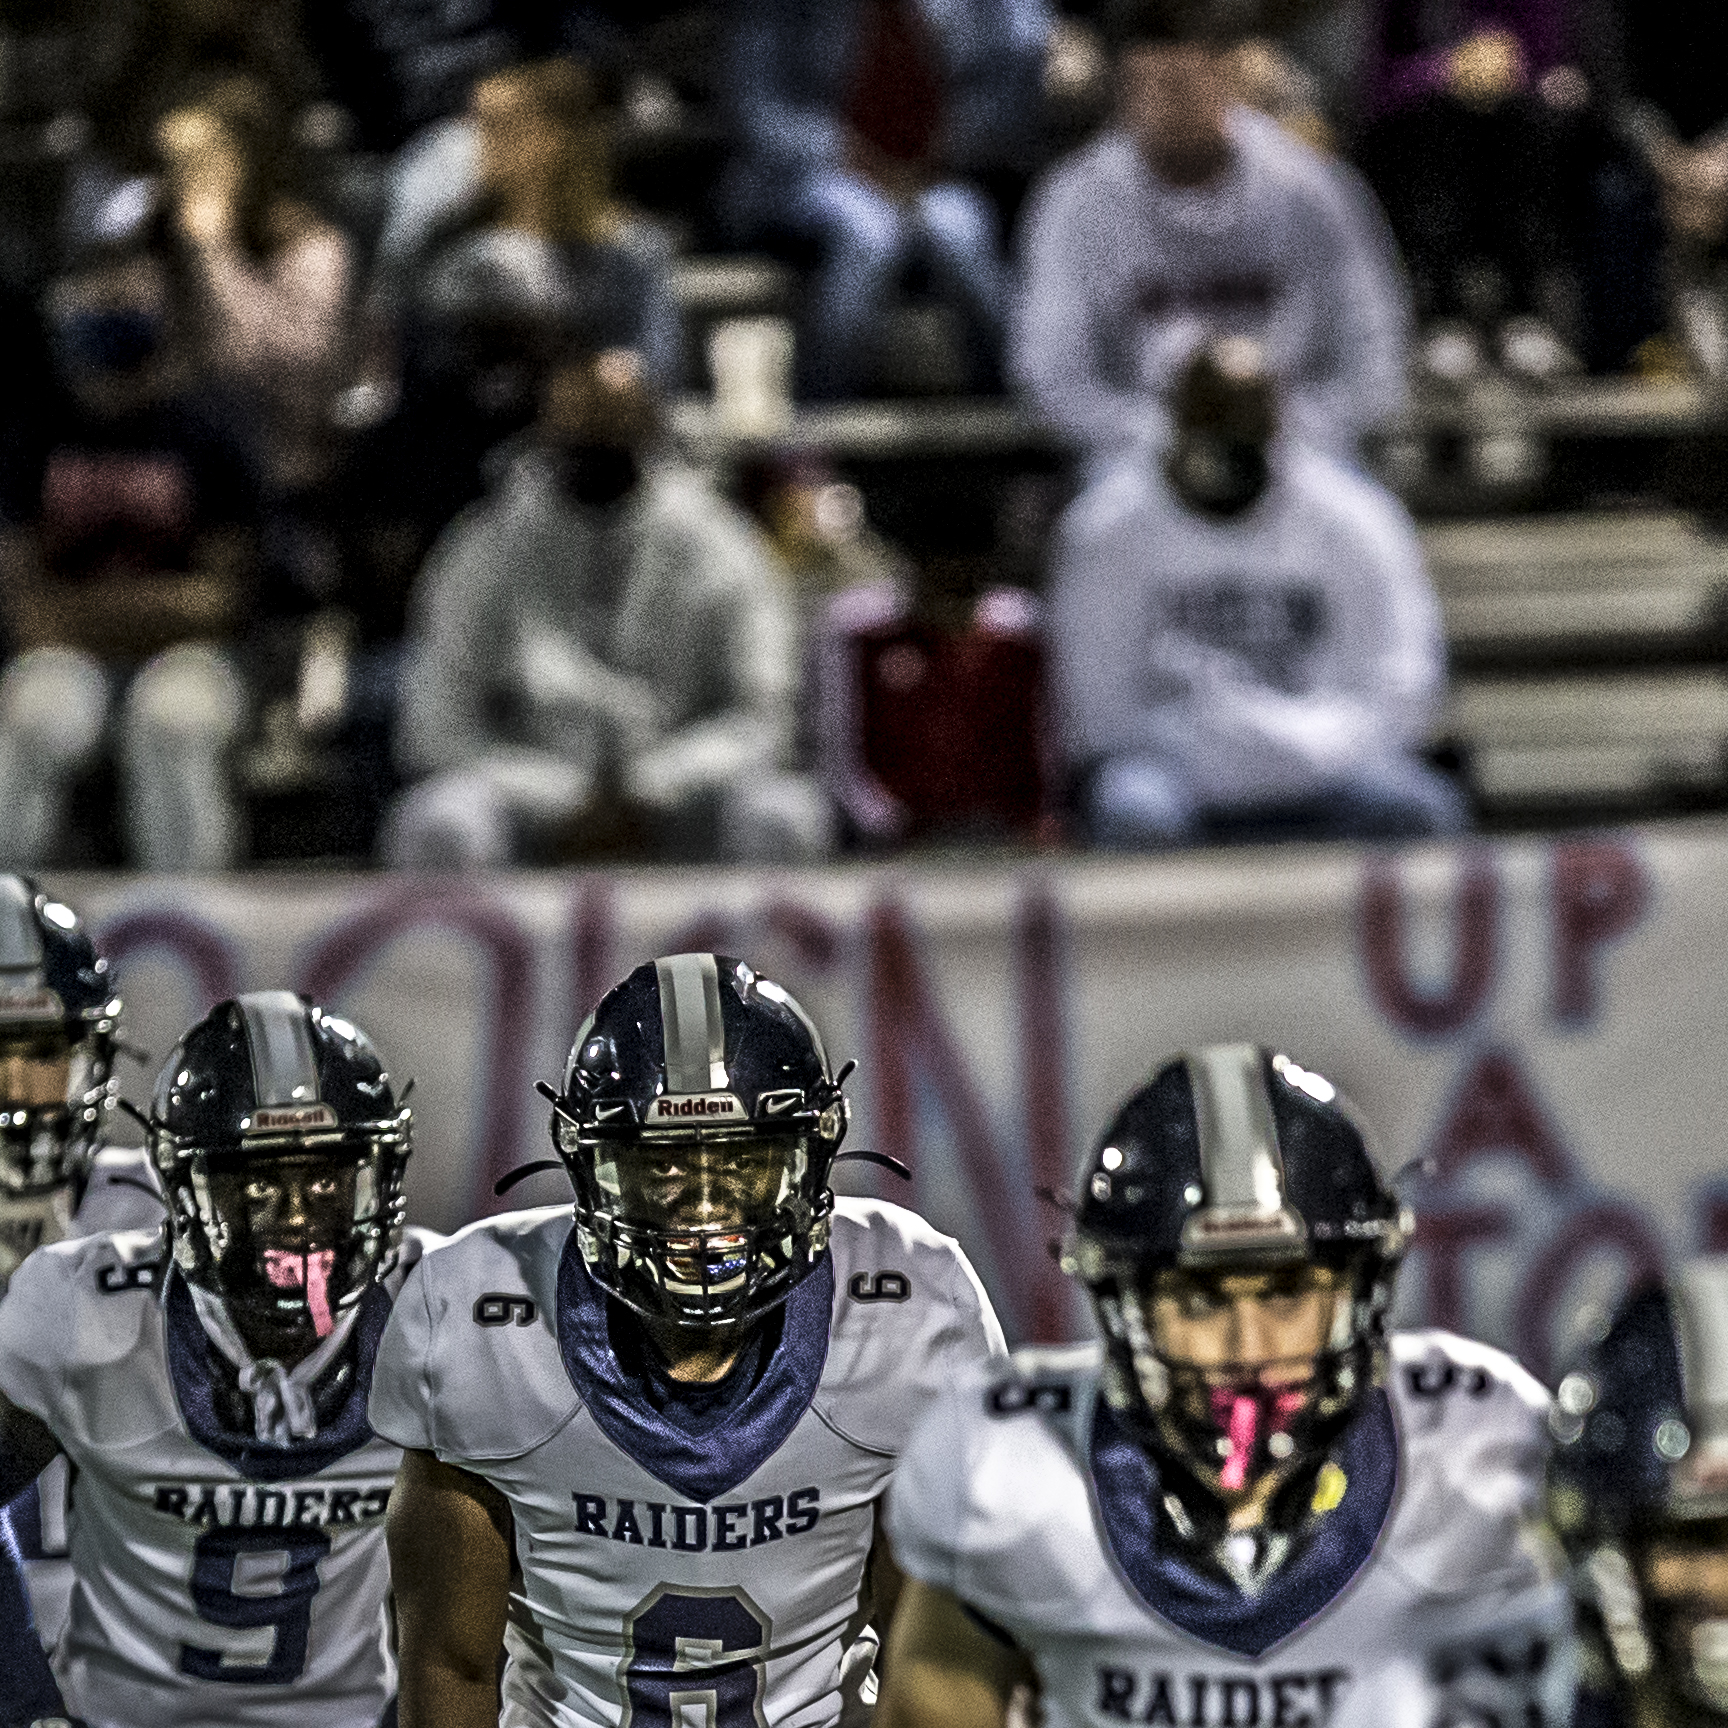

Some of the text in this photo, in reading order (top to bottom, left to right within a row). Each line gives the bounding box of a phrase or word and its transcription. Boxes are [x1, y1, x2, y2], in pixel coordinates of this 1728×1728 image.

[1354, 835, 1654, 1040] UP
[155, 1486, 392, 1528] RAIDERS
[572, 1486, 822, 1554] RAIDERS
